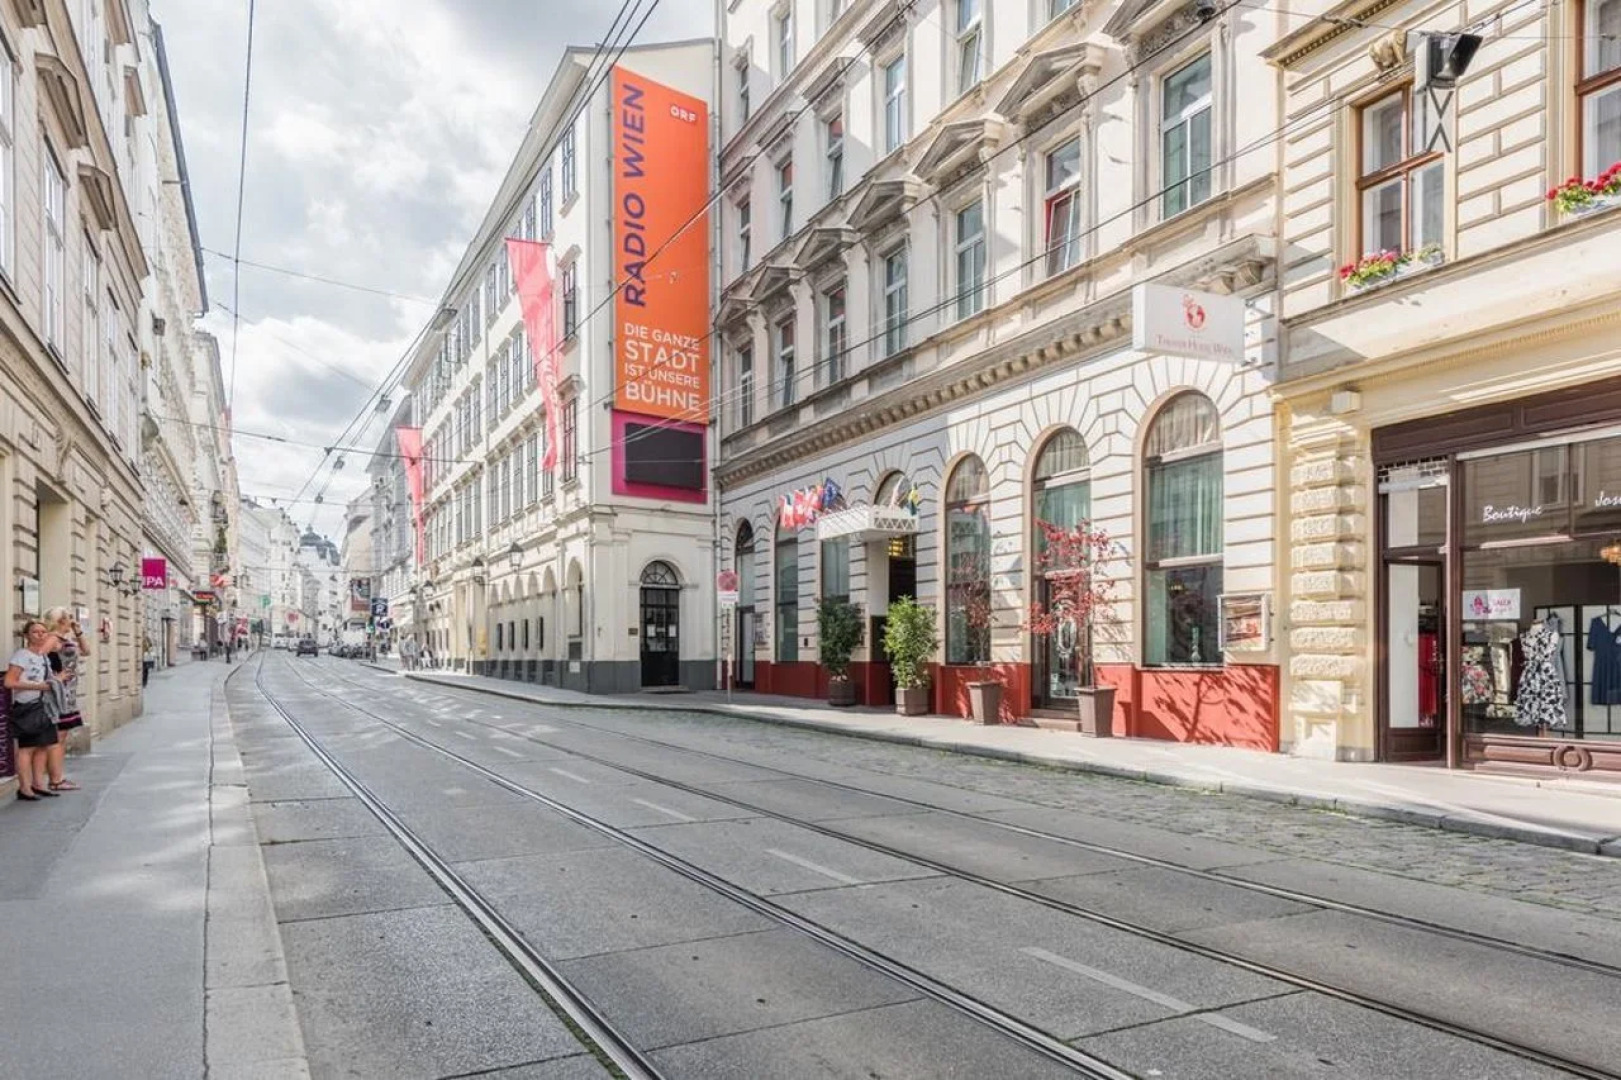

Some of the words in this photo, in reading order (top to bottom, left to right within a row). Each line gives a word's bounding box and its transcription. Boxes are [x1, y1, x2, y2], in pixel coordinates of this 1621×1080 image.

[671, 105, 696, 122] ORF
[623, 84, 645, 177] WIEN
[624, 193, 646, 307] RADIO
[625, 322, 648, 339] DIE
[652, 329, 700, 352] GANZE
[626, 340, 700, 373] STADT
[625, 362, 645, 377] IST
[649, 367, 700, 390] UNSERE
[626, 379, 700, 412] BÜHNE
[1482, 504, 1542, 524] Boutique
